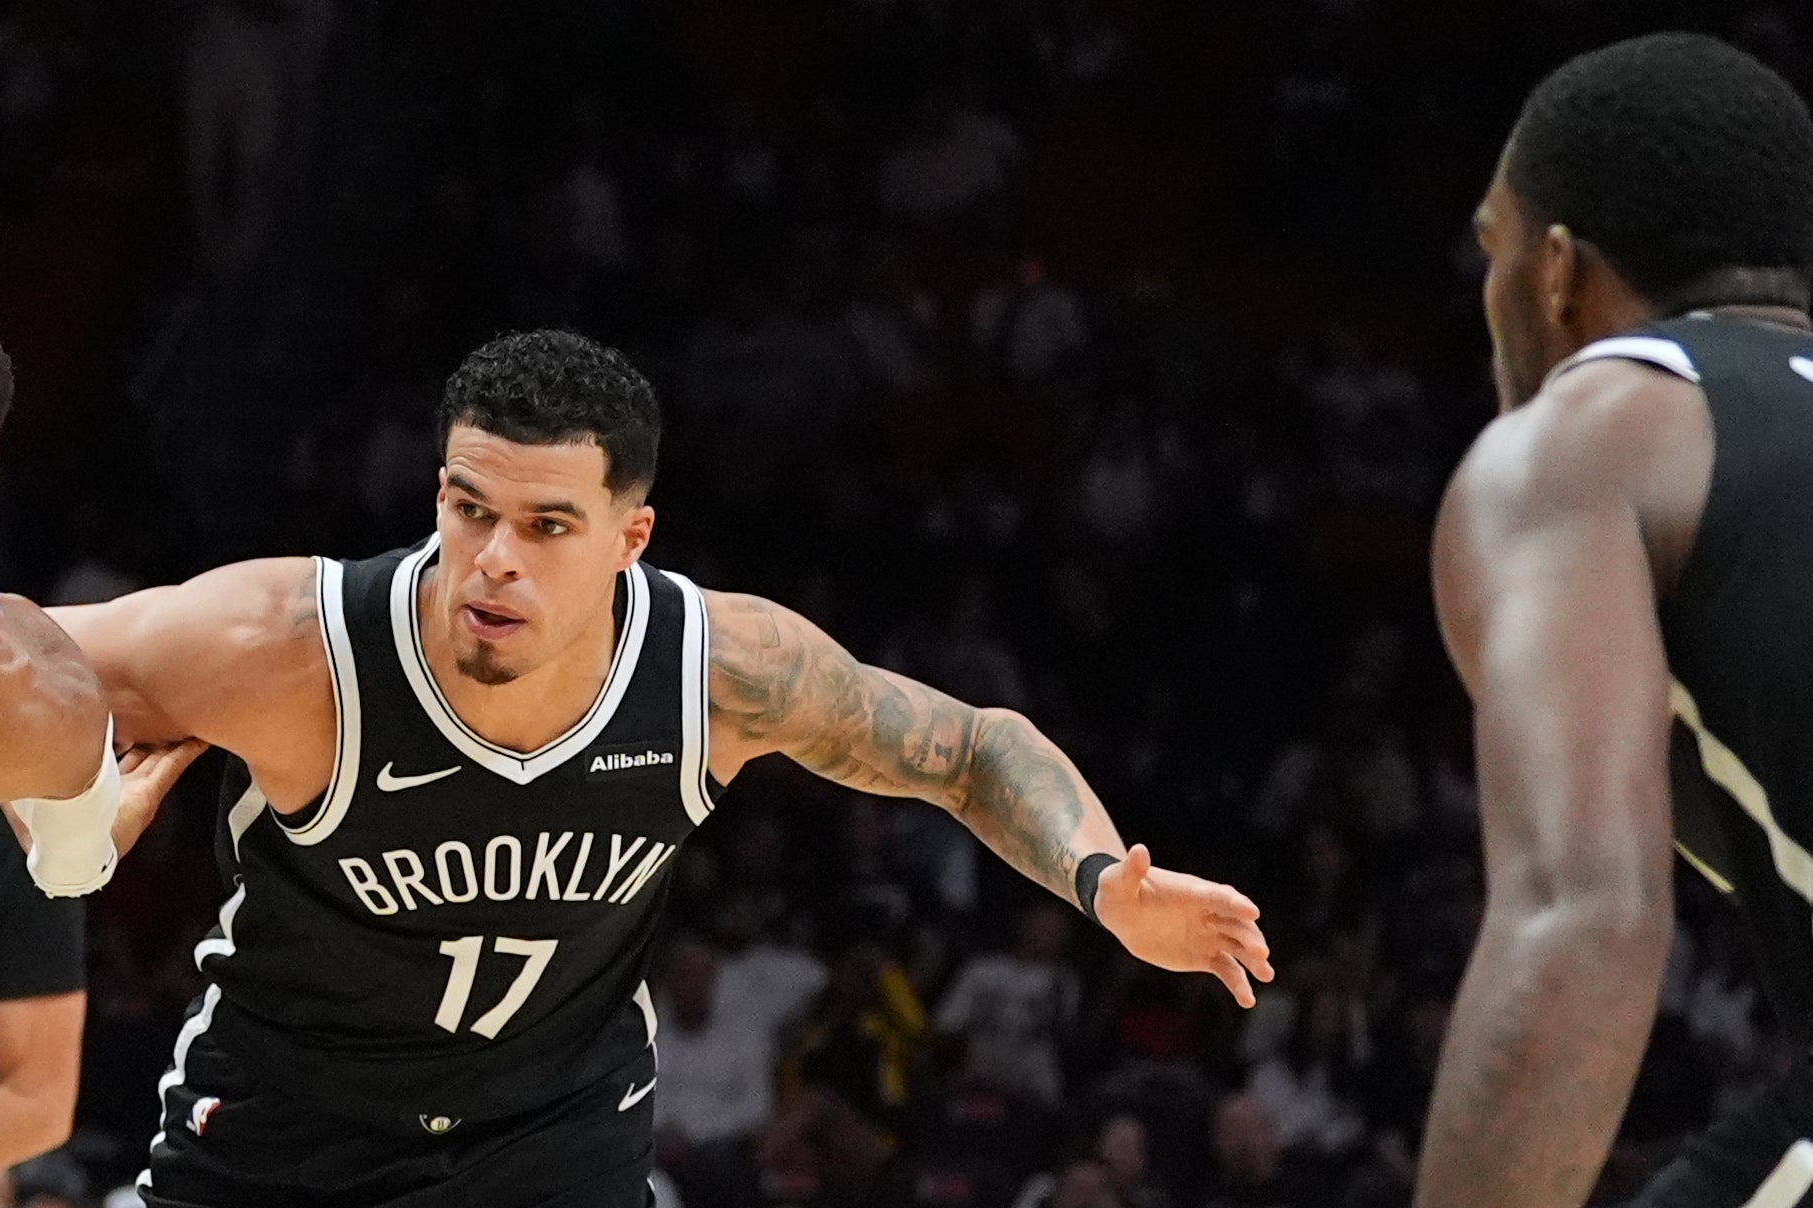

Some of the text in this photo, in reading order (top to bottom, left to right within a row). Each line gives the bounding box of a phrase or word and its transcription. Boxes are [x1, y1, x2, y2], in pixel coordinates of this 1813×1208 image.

[590, 750, 673, 773] Alibaba
[338, 832, 675, 915] BROOKLYN
[434, 936, 559, 1040] 17
